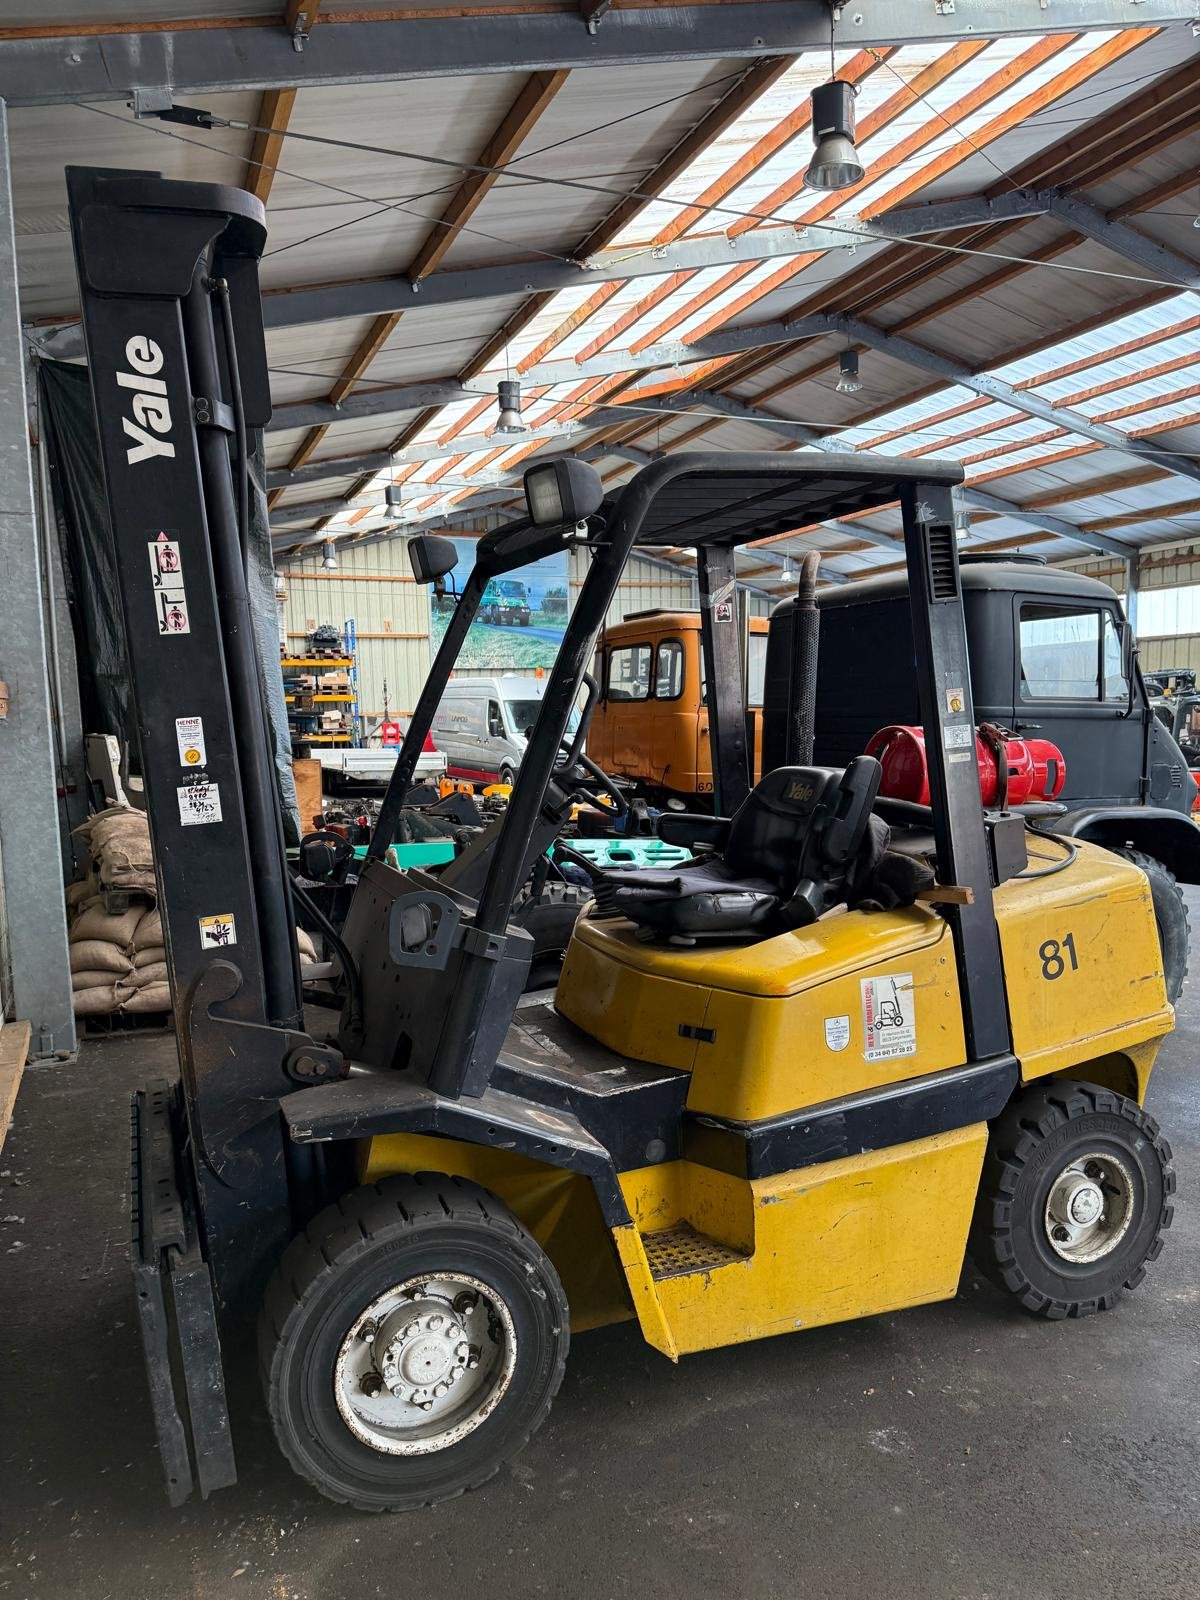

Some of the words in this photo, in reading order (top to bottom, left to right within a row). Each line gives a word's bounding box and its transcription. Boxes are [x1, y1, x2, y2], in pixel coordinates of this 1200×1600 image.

[115, 335, 176, 465] Yale
[787, 782, 814, 802] Yale
[1038, 932, 1079, 981] 81
